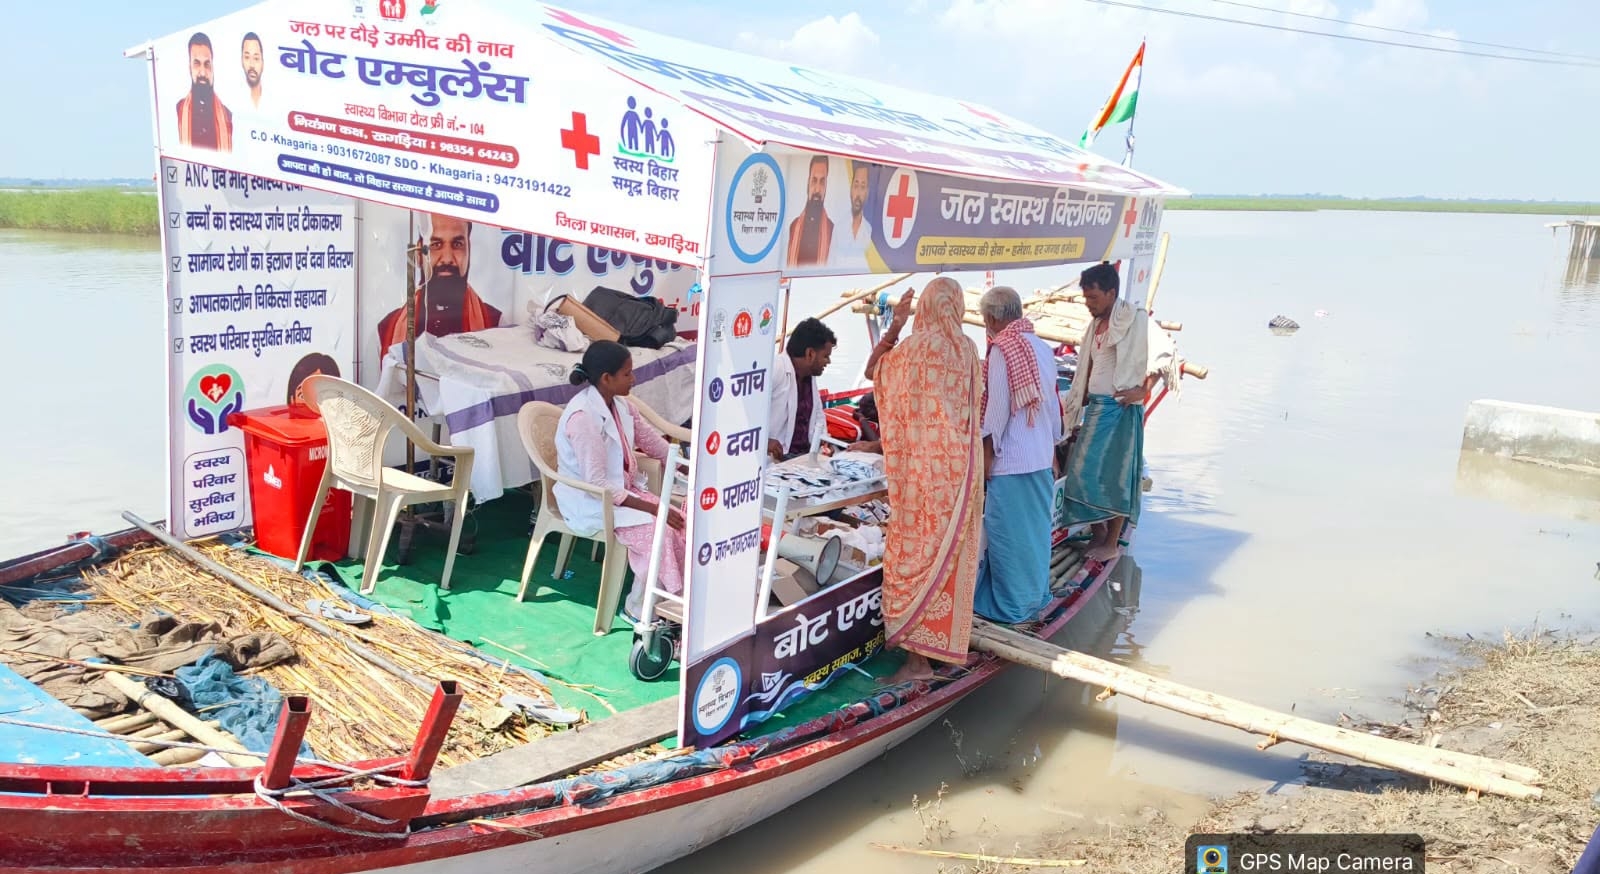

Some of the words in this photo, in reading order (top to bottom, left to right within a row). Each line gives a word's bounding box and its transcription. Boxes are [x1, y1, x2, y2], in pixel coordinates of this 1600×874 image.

[289, 20, 320, 36] जल
[325, 24, 346, 39] पर
[350, 23, 379, 48] दौड़े
[385, 28, 440, 50] उम्मीद
[446, 33, 472, 53] की
[477, 41, 515, 59] नाव
[278, 39, 347, 78] बोट
[355, 58, 530, 106] एम्बुलेंस
[344, 103, 375, 119] स्वास्थ्य
[378, 104, 407, 124] विभाग
[410, 110, 429, 128] टोल
[430, 112, 444, 129] फ्री
[470, 123, 485, 135] 104
[293, 114, 337, 133] नियंत्रण
[372, 130, 427, 150] खगड़िया
[439, 142, 474, 156] 98354
[477, 147, 514, 163] 64243
[185, 163, 209, 188] ANC
[212, 168, 227, 190] एव
[282, 160, 307, 171] आपदा
[308, 163, 321, 175] की
[322, 166, 332, 177] हो
[354, 172, 365, 184] तो
[366, 174, 391, 189] बिहार
[392, 182, 423, 197] सरकार
[424, 186, 434, 198] है
[435, 189, 464, 203] आपके
[327, 144, 391, 166] 9031672087
[394, 157, 419, 170] SDO
[430, 162, 482, 182] Khagaria
[494, 174, 571, 198] 9473191422
[648, 160, 680, 182] बिहार
[647, 179, 680, 201] बिहार
[186, 204, 211, 231] बच्चों
[213, 212, 227, 231] का
[229, 212, 262, 231] स्वास्थ्य
[264, 205, 285, 231] जांच
[287, 206, 302, 232] एवं
[302, 205, 342, 231] टीकाकरण
[757, 207, 778, 222] विभाग
[941, 187, 989, 225] जल
[1050, 187, 1115, 227] क्लिनिक
[555, 211, 587, 231] जिला
[645, 233, 700, 254] खगड़िया
[188, 253, 225, 272] सामान्य
[227, 246, 249, 271] रोगों
[250, 252, 264, 270] का
[266, 252, 293, 273] इलाज
[295, 245, 310, 270] एवं
[310, 252, 325, 269] दवा
[327, 244, 354, 269] वितरण
[919, 241, 948, 257] आपके
[948, 244, 976, 257] स्वास्थ्य
[977, 241, 989, 257] की
[990, 242, 1005, 256] सेवा
[1034, 245, 1044, 256] हर
[189, 285, 252, 314] आपातकालीन
[255, 284, 292, 310] चिकित्सा
[294, 289, 327, 309] सहायता
[190, 334, 217, 354] स्वस्थ
[219, 324, 250, 350] परिवार
[252, 322, 283, 357] सुरक्षित
[285, 320, 312, 345] भविष्य
[731, 360, 767, 397] जांच
[727, 426, 762, 456] दवा
[194, 455, 231, 470] स्वस्थ
[192, 473, 237, 489] परिवार
[723, 466, 762, 510] परामर्श
[189, 492, 236, 513] सुरक्षित
[194, 510, 236, 527] भविष्य
[773, 610, 832, 659] बोट
[803, 664, 830, 689] स्वस्थ
